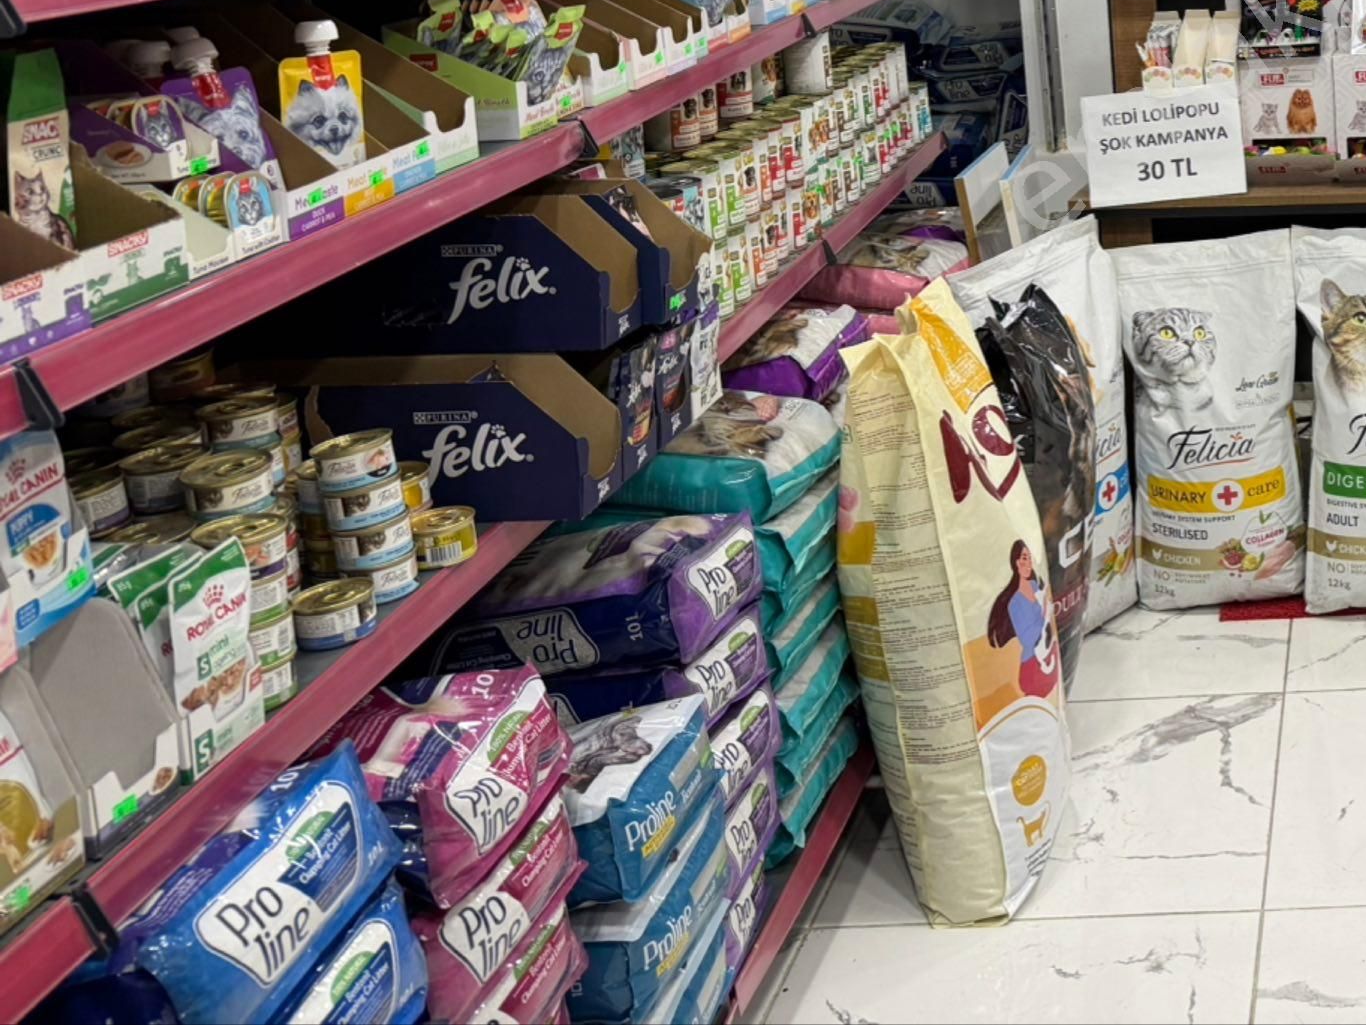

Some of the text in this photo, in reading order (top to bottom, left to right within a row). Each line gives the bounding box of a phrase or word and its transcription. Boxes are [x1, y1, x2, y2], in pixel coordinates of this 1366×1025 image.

[1102, 101, 1221, 127] KEDİ LOLİPOPU
[1099, 125, 1229, 155] ŞOK KAMPANYA
[1136, 157, 1198, 182] 30 TL
[451, 245, 496, 257] PURINA
[447, 256, 550, 324] felix
[425, 412, 470, 424] PURINA
[420, 422, 527, 487] felix
[1167, 429, 1256, 471] Felicia
[20, 463, 60, 494] CANIN
[1150, 480, 1281, 505] URINARY care
[1177, 514, 1203, 523] SYSTEM
[1203, 514, 1236, 523] SUPPORT
[1326, 498, 1359, 510] DIGESTIVE
[1151, 522, 1209, 541] STERILISED
[1326, 512, 1360, 528] ADULT
[1244, 528, 1286, 546] COLLAGEN
[1163, 553, 1201, 566] CHICKEN
[1327, 562, 1346, 574] NO
[697, 564, 727, 596] Pro
[1153, 570, 1170, 582] NO
[1328, 578, 1351, 591] 12kg
[713, 584, 738, 617] line
[516, 614, 566, 642] line
[627, 608, 645, 641] 10L
[533, 639, 578, 665] Pro
[702, 660, 727, 695] Pro
[709, 678, 734, 715] line
[197, 737, 211, 765] S
[480, 795, 521, 847] line
[625, 786, 678, 853] Proline
[215, 884, 285, 949] Pro
[458, 894, 508, 950] Pro
[253, 905, 311, 977] line
[480, 917, 522, 977] line
[643, 904, 694, 973] Proline
